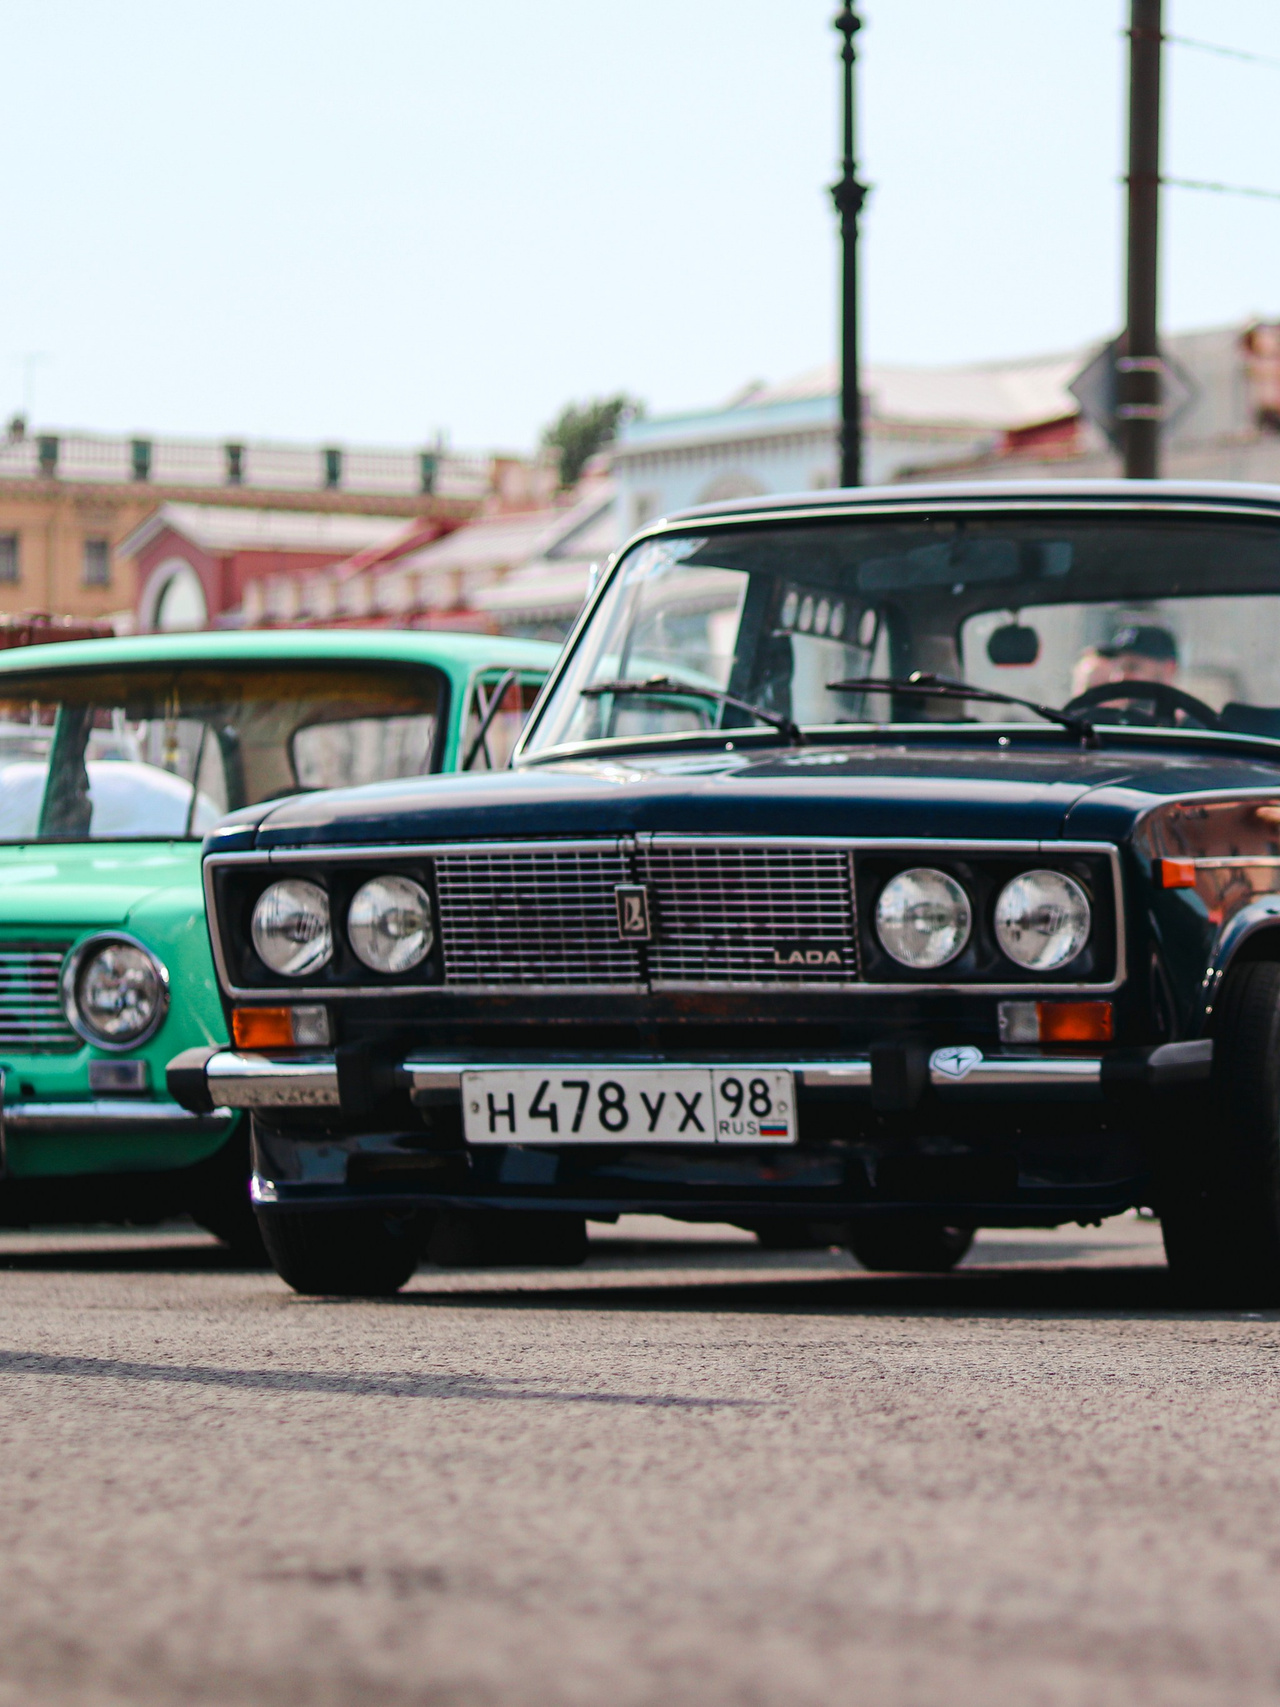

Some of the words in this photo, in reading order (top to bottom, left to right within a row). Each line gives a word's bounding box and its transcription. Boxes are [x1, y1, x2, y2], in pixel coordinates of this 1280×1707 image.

[774, 950, 841, 964] LADA
[720, 1077, 773, 1118] 98
[719, 1121, 757, 1135] RUS
